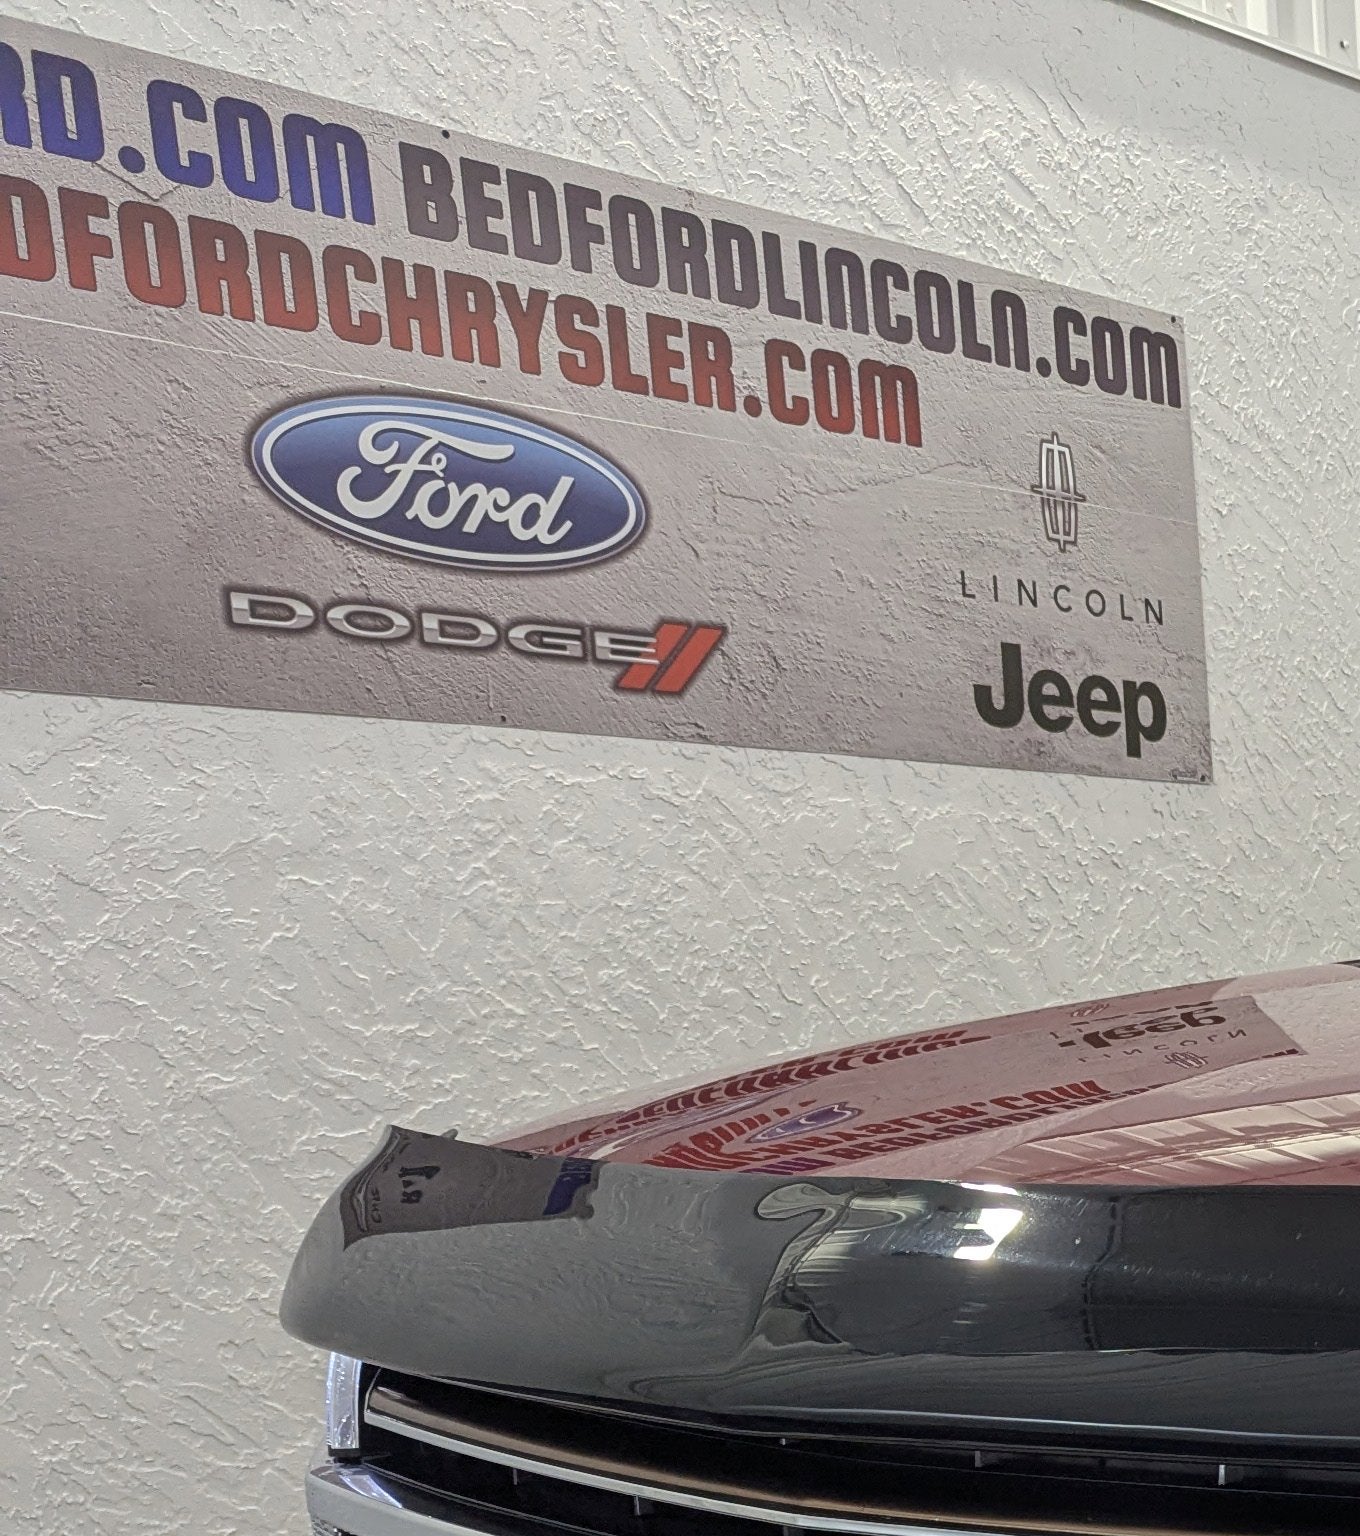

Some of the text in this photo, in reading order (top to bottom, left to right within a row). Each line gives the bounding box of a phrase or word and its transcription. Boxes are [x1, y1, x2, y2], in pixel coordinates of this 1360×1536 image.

[400, 142, 1183, 408] BEDFORDLINCOLN.COM
[337, 419, 575, 545] Ford
[230, 591, 660, 665] DODGE
[959, 570, 1166, 627] LINCOLN
[974, 642, 1168, 758] Jeep
